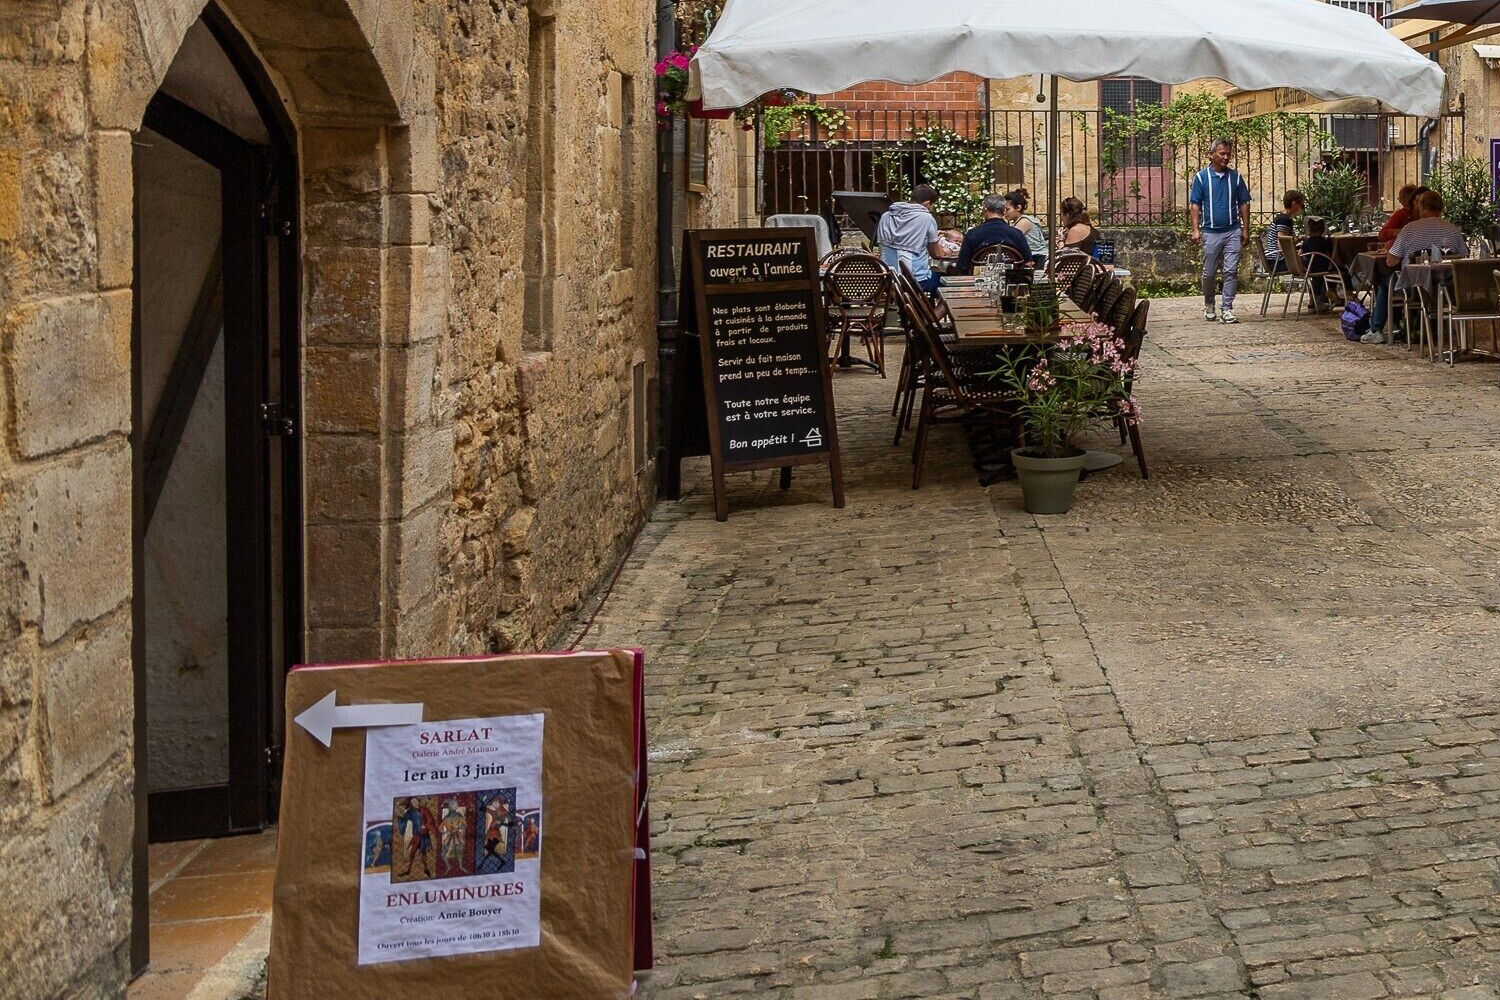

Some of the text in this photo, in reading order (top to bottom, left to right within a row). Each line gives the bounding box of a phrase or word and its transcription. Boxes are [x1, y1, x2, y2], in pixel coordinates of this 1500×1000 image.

[707, 242, 801, 258] RESTAURANT
[710, 262, 802, 277] ouvert à l'année
[712, 307, 728, 315] Nos
[732, 305, 750, 315] plats
[726, 316, 755, 324] cuisinés
[758, 314, 762, 322] à
[765, 314, 772, 322] la
[775, 312, 807, 321] demande
[715, 328, 720, 336] à
[728, 328, 752, 336] partir
[777, 322, 808, 332] produits
[716, 338, 736, 347] frais
[750, 336, 776, 344] locaux.
[718, 353, 801, 367] Servir du fait maison
[720, 370, 742, 382] prend
[756, 370, 770, 380] peu
[773, 368, 782, 376] de
[724, 394, 810, 409] Toute notre équipe
[726, 406, 816, 422] est à votre service.
[730, 439, 748, 450] Bon
[751, 434, 788, 449] appétit
[420, 728, 493, 745] SARLAT
[412, 746, 499, 758] Galerie André Malraux
[404, 762, 505, 782] 1er au 13 juin
[386, 882, 524, 908] ENLUMINURES
[438, 910, 466, 920] Annie
[469, 908, 502, 919] Bouyer
[377, 942, 404, 950] Ouvert
[406, 940, 422, 948] tous
[436, 936, 456, 946] jours
